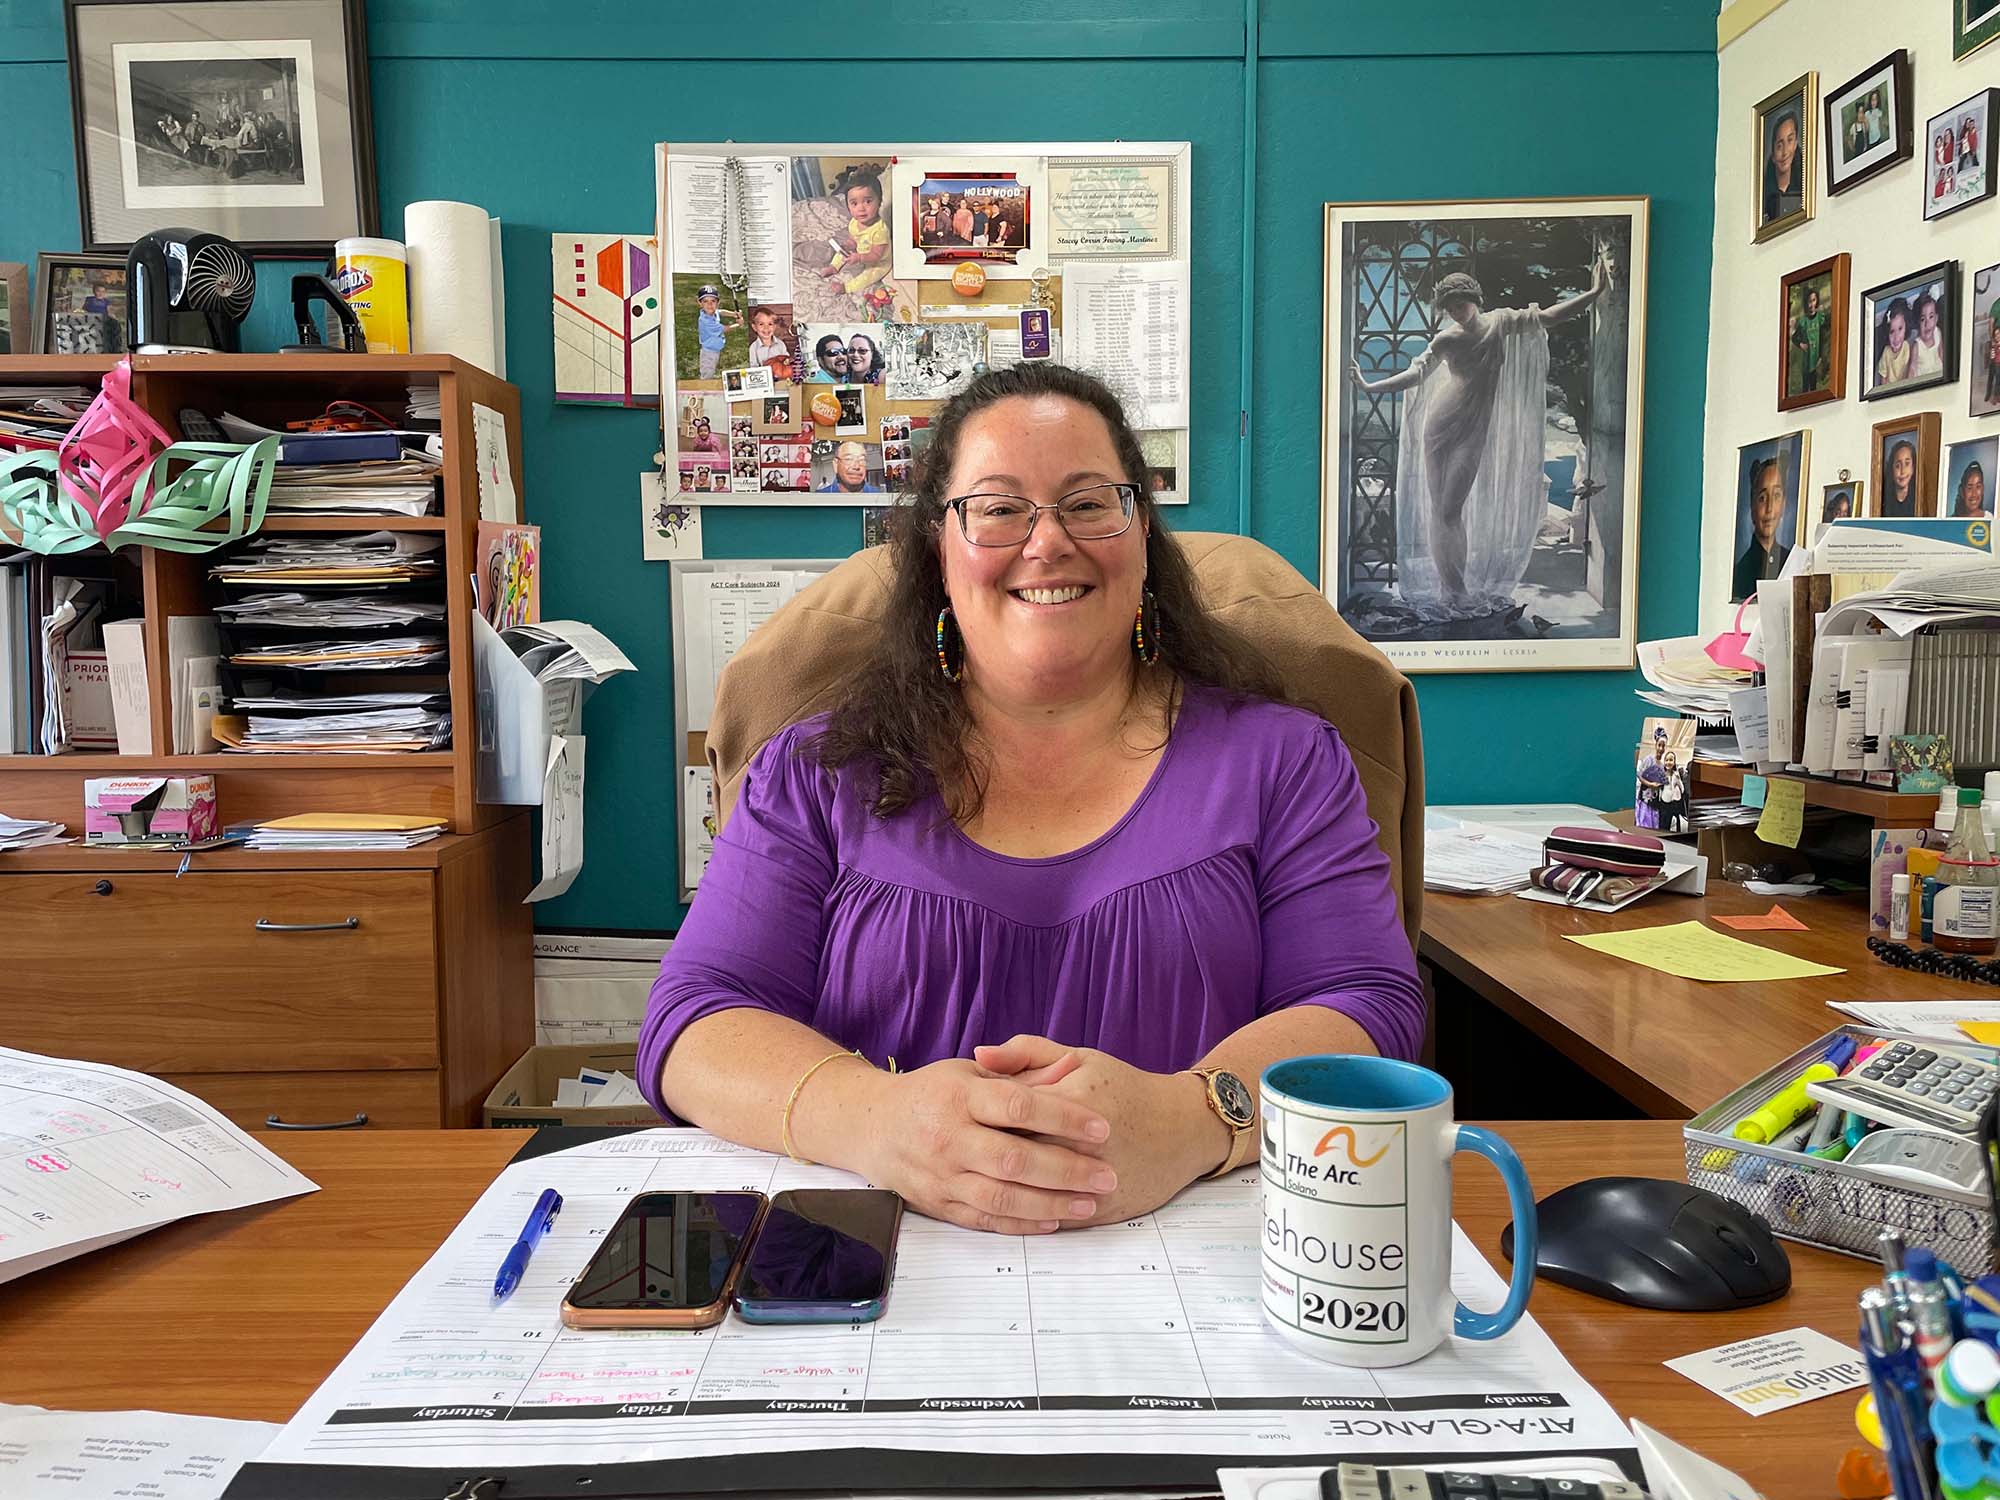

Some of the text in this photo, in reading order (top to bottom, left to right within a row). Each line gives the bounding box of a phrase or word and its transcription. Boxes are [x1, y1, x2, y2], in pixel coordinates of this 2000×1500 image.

[964, 187, 1020, 198] HOLLYWOOD
[74, 664, 108, 673] PRIOR
[86, 674, 108, 682] MAI
[1288, 1153, 1318, 1178] The
[1288, 1178, 1318, 1196] Solano
[32, 1211, 54, 1222] 20
[1264, 1195, 1404, 1272] ehouse
[1302, 1292, 1406, 1332] 2020
[1164, 1320, 1174, 1330] 6
[668, 1388, 680, 1396] 2
[920, 1398, 1025, 1410] Wednesday
[1128, 1396, 1203, 1408] Tuesday
[1302, 1397, 1376, 1410] Monday
[1484, 1394, 1552, 1406] Sunday
[616, 1404, 674, 1415] Friday
[766, 1400, 849, 1412] Thursday
[412, 1407, 497, 1418] Saturday
[1257, 1432, 1292, 1441] Notes
[1558, 1480, 1574, 1491] 0
